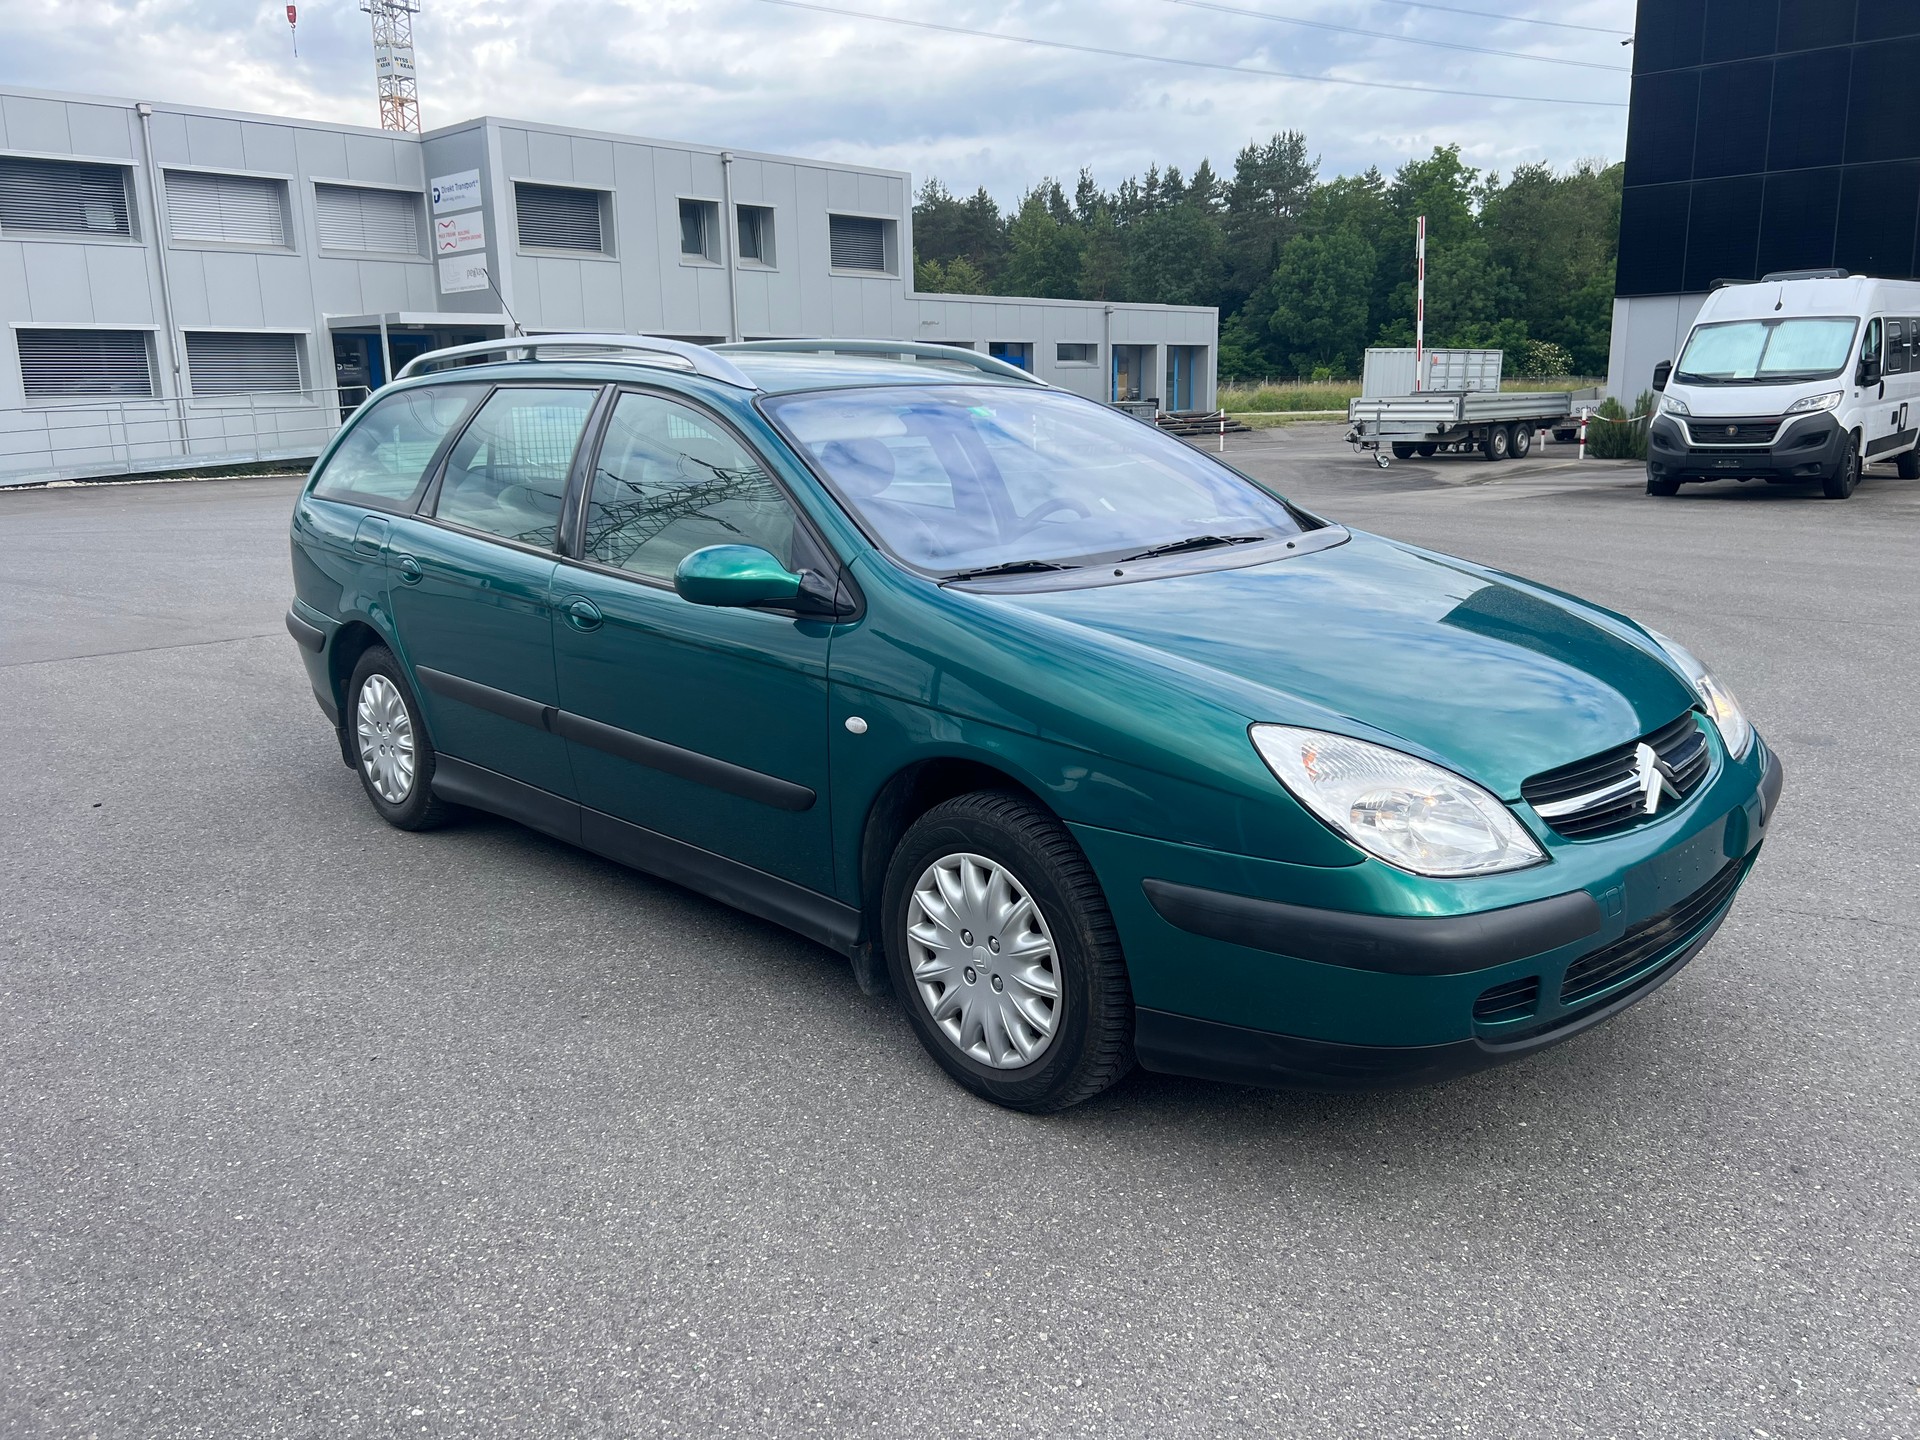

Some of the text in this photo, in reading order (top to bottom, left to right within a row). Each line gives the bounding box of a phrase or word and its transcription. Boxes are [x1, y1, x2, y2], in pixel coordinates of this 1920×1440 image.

[400, 62, 414, 70] KRAN
[441, 184, 455, 194] Direkt
[1575, 404, 1600, 414] scho
